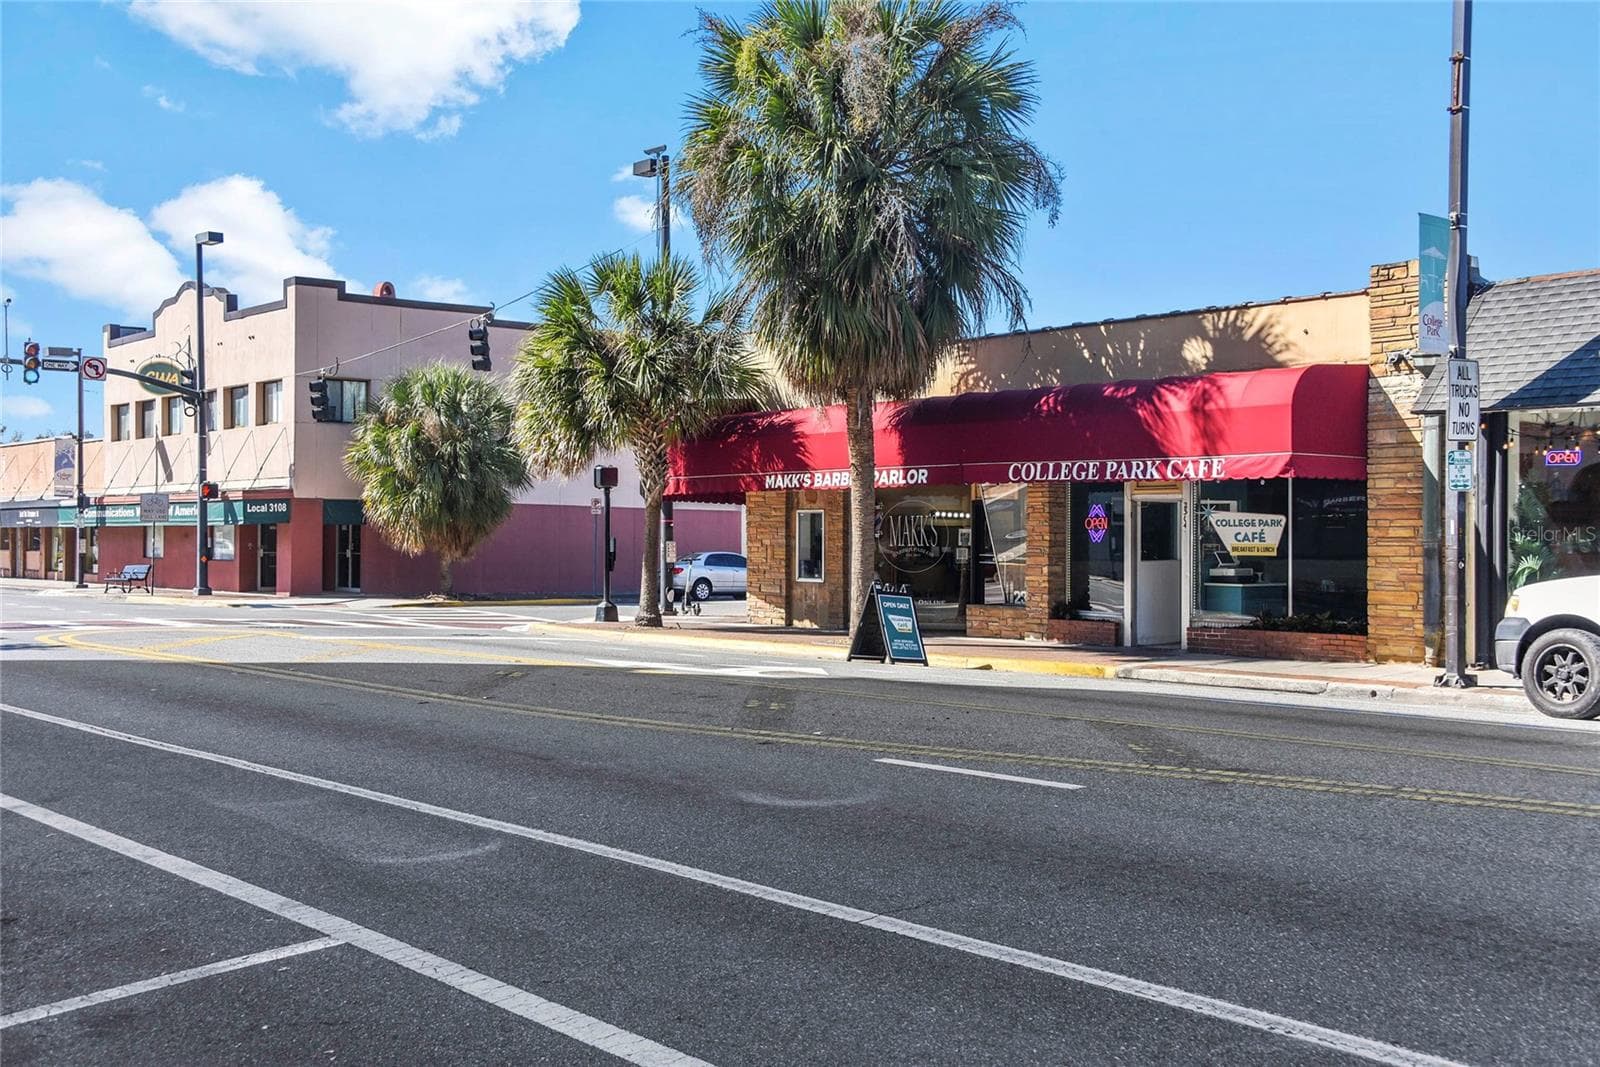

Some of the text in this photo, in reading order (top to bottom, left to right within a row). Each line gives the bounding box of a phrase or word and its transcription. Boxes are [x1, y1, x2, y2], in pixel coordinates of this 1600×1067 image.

[1423, 313, 1442, 327] College
[1427, 326, 1440, 337] Park
[1457, 365, 1471, 380] ALL
[1451, 384, 1478, 398] TRUCKS
[1458, 402, 1470, 417] NO
[1452, 421, 1475, 435] TURNS
[1548, 452, 1579, 464] OPEN
[1008, 458, 1226, 481] COLLEGE PARK CAFE
[765, 473, 810, 489] MAKK'S
[813, 471, 852, 486] BARB
[247, 503, 287, 513] Local 3108
[890, 513, 938, 547] MAKK'S
[1084, 517, 1108, 530] OPEN
[1215, 519, 1283, 528] COLLEGE PARK
[1234, 529, 1266, 543] CAFÉ
